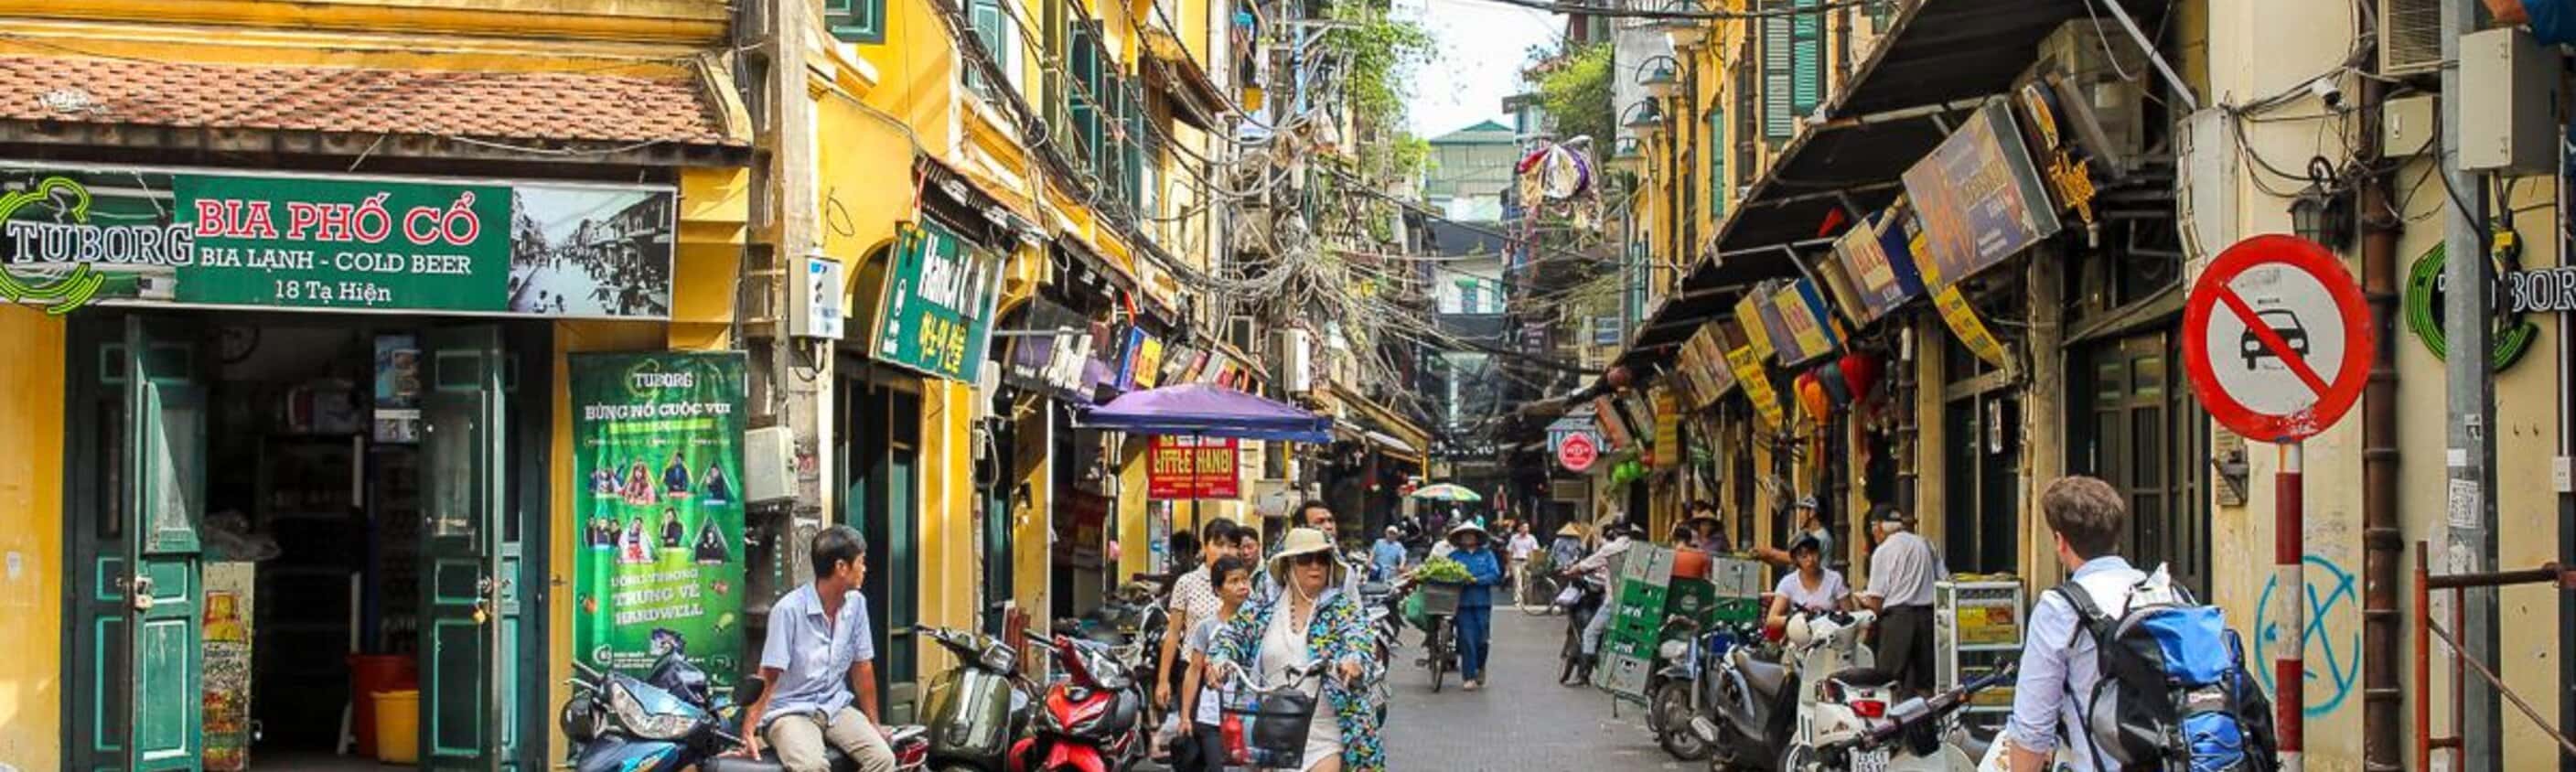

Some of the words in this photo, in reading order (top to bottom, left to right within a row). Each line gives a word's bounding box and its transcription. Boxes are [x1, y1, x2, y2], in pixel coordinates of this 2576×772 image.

[195, 199, 278, 239] BIA
[287, 191, 391, 243] PHỐ
[403, 190, 480, 246] CỔ
[6, 219, 195, 266] TUBORG
[201, 248, 242, 268] BIA
[247, 249, 316, 273] LẠNH
[335, 252, 405, 272] COLD
[411, 254, 472, 274] BEER
[276, 280, 300, 299] 18
[306, 281, 334, 305] Tạ
[338, 282, 392, 306] Hiện
[635, 372, 693, 389] TUBORG
[1154, 448, 1193, 474] LITTLE
